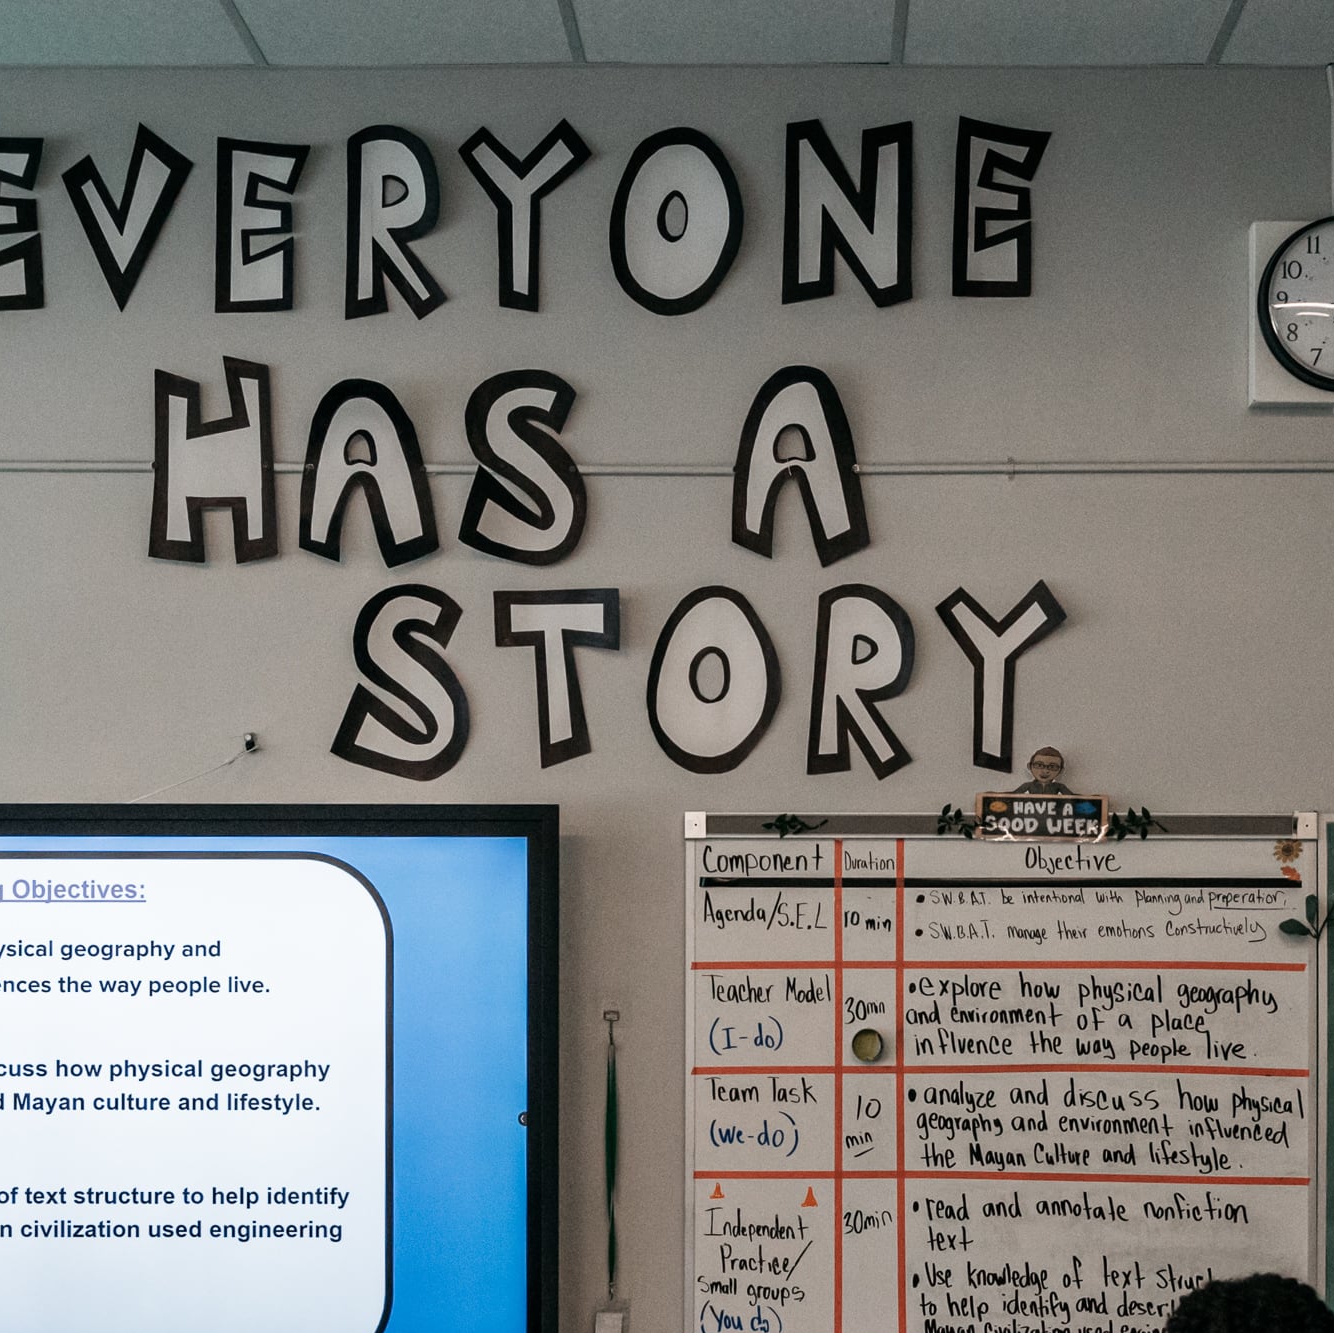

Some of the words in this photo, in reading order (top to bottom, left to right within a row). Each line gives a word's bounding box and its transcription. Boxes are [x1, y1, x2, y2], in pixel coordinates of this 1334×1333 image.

[1305, 234, 1319, 253] 11
[1280, 259, 1302, 279] 10
[1275, 291, 1289, 308] 9
[1287, 323, 1298, 341] 8
[1311, 348, 1322, 366] 7
[146, 353, 589, 568] HAS
[732, 365, 871, 568] A
[328, 577, 1067, 784] STORY
[1012, 800, 1057, 816] HAVE
[1062, 800, 1075, 816] A
[1046, 818, 1099, 836] WEEK
[703, 844, 823, 876] Component
[845, 851, 894, 870] Duration
[1026, 845, 1121, 874] Objective
[10, 880, 146, 903] Objectives:
[61, 941, 175, 960] geography
[182, 941, 220, 957] and
[58, 976, 92, 992] the
[99, 981, 142, 996] way
[150, 977, 220, 996] people
[229, 976, 269, 993] live.
[703, 975, 773, 1003] Teacher
[786, 974, 830, 1003] Model
[919, 975, 1001, 1007] explore
[1019, 971, 1060, 999] how
[1078, 975, 1162, 1012] physical
[1177, 979, 1278, 1016] geography
[906, 1000, 941, 1024] and
[951, 1000, 1062, 1026] environment
[1077, 1008, 1107, 1031] of
[1119, 1014, 1132, 1029] a
[1152, 1006, 1208, 1038] place
[710, 1016, 783, 1055] (I-do)
[1031, 1030, 1062, 1054] the
[1076, 1038, 1115, 1059] way
[1130, 1036, 1191, 1063] people
[1205, 1030, 1256, 1061] live.
[25, 1188, 66, 1204] text
[74, 1188, 174, 1204] structure
[183, 1188, 203, 1204] to
[213, 1187, 259, 1209] help
[268, 1187, 349, 1209] identify
